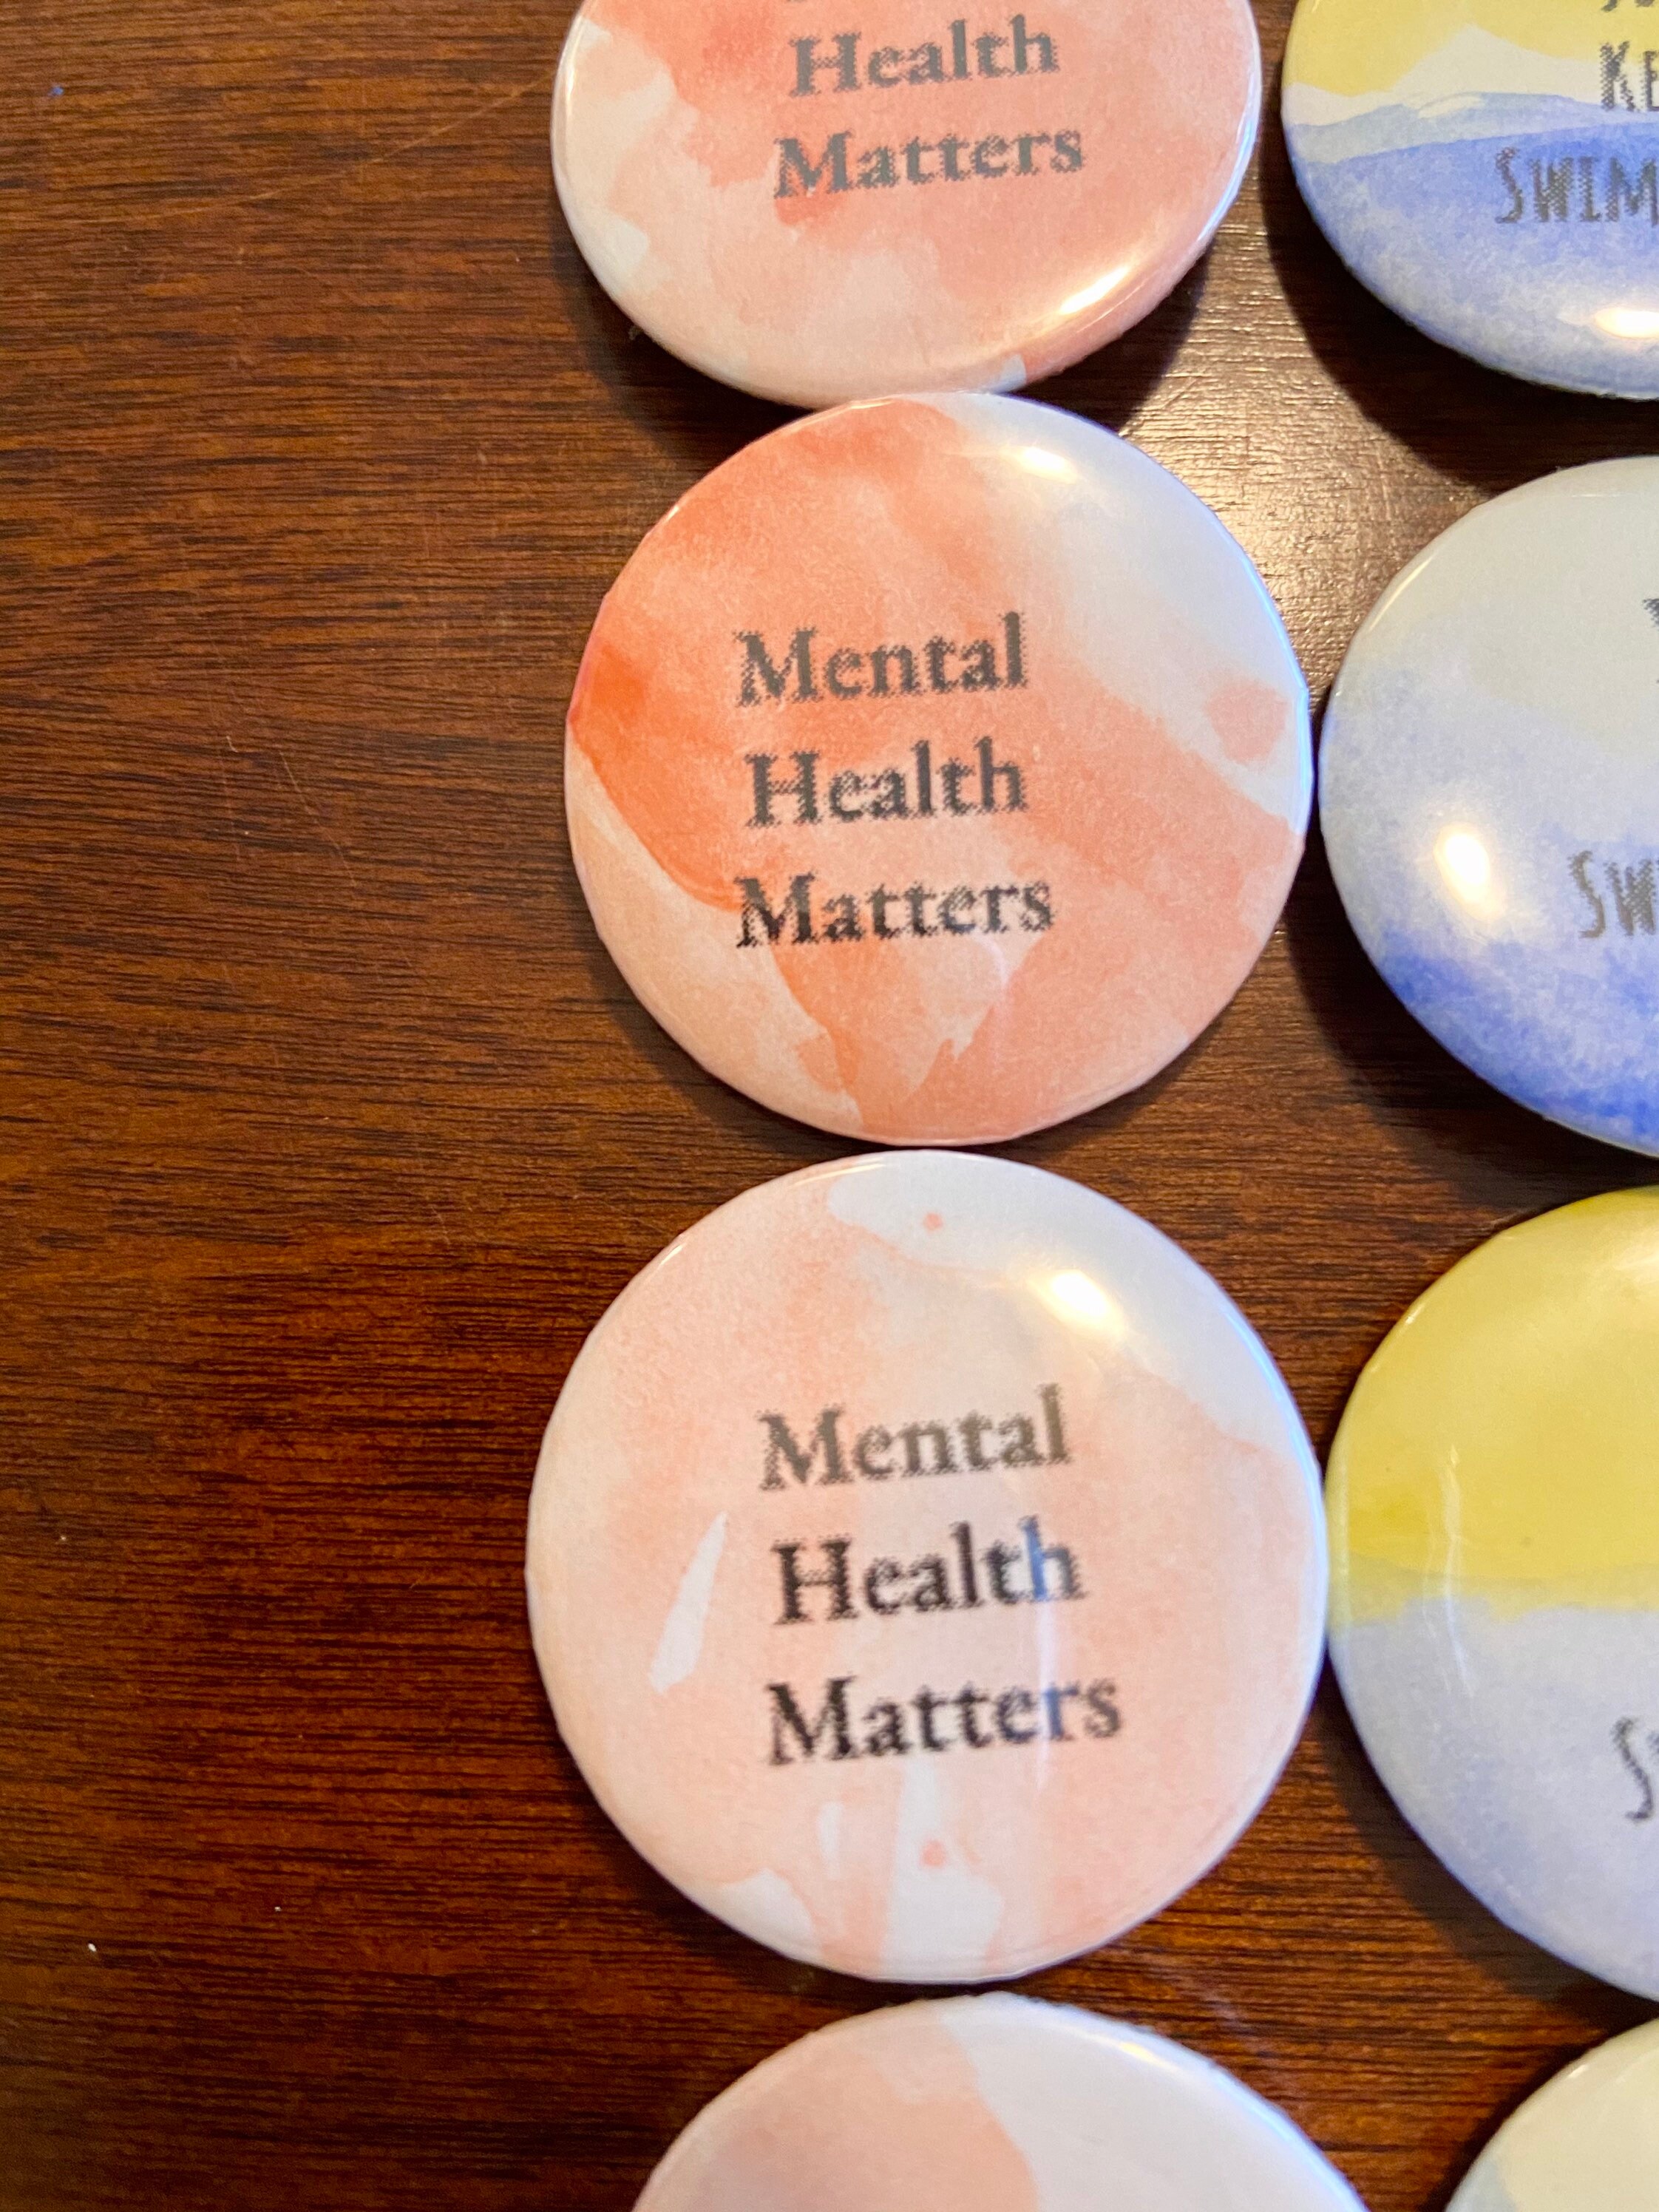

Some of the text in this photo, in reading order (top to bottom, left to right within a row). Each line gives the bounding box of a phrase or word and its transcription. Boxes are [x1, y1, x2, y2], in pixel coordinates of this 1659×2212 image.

[788, 14, 1059, 97] Health
[774, 130, 1085, 200] Matters
[733, 611, 1028, 708] Mental
[744, 736, 1028, 828] Health
[733, 872, 1055, 948] Matters
[756, 1382, 1072, 1491] Mental
[770, 1513, 1088, 1625] Health
[764, 1672, 1124, 1765] Matters
